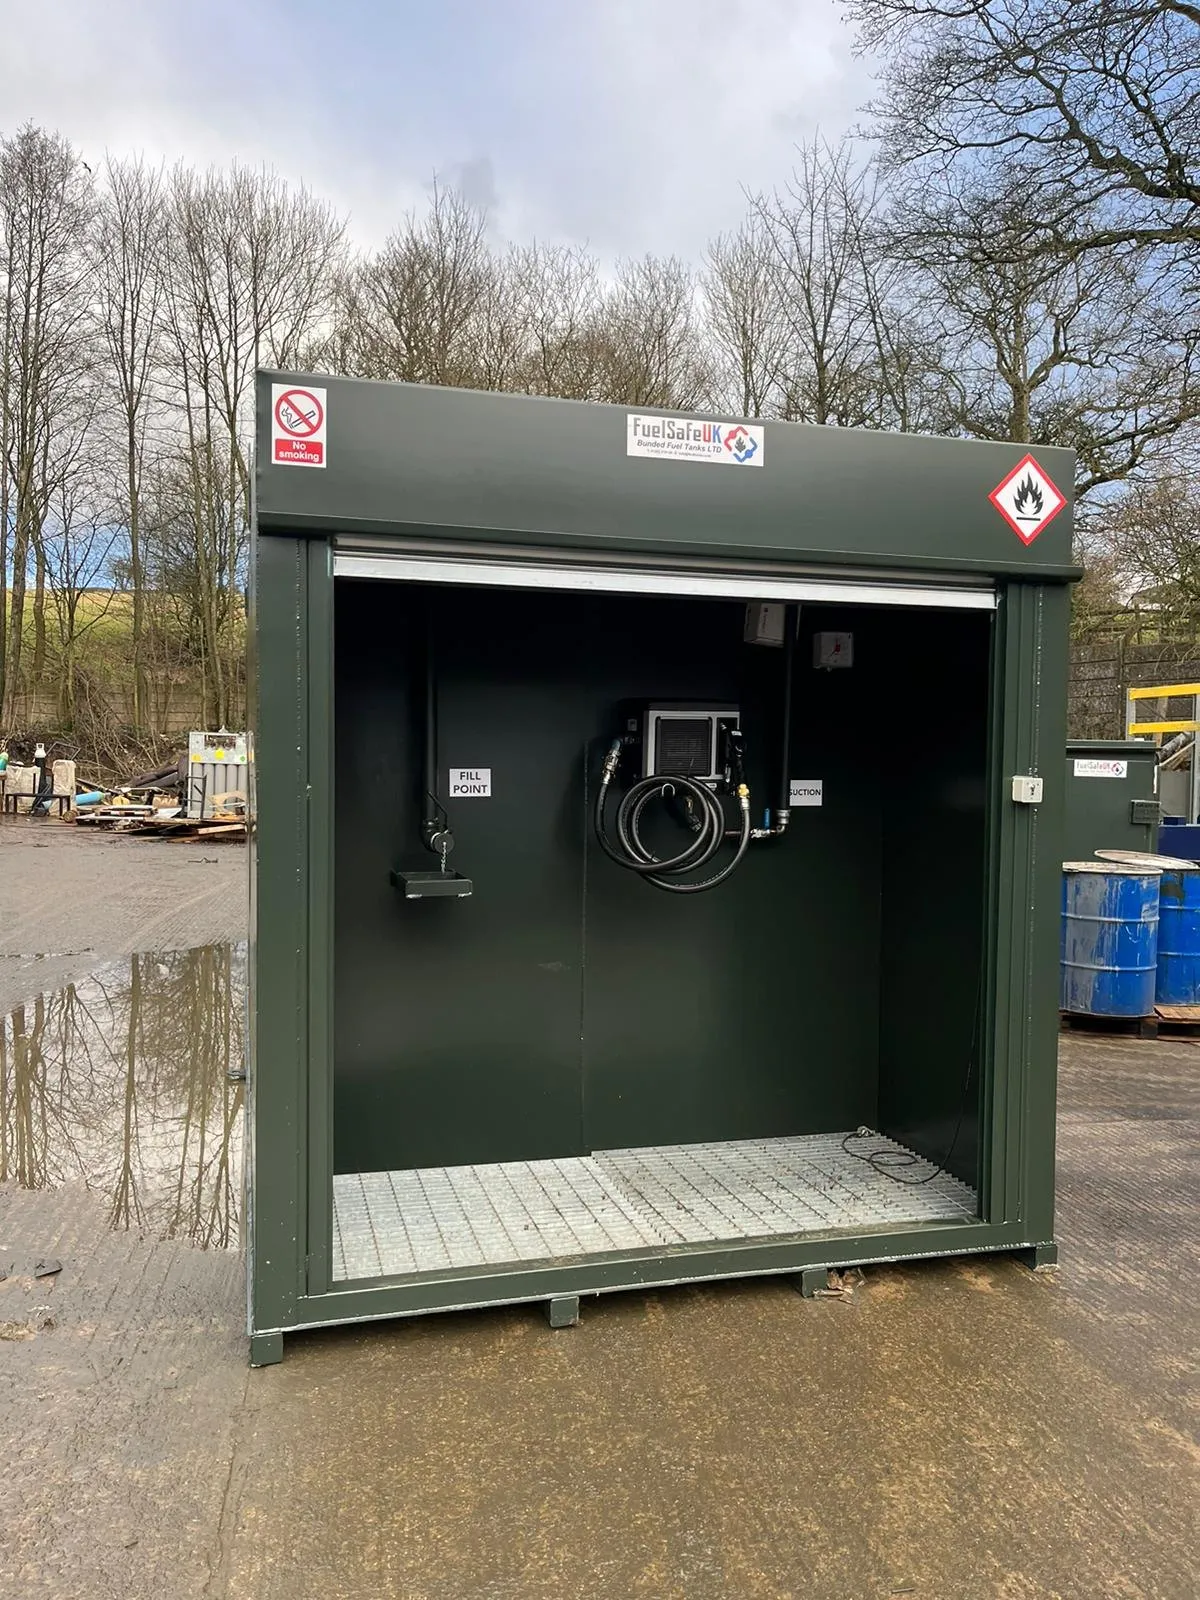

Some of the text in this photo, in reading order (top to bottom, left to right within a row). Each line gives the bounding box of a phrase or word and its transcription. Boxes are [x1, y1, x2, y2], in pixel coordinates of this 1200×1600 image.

[292, 441, 307, 450] No
[637, 439, 666, 449] Bunded
[666, 441, 683, 450] Fuel
[685, 444, 706, 453] Tanks
[707, 446, 722, 454] LTD
[278, 450, 320, 462] smoking
[459, 771, 481, 781] FILL
[453, 784, 488, 794] POINT
[789, 788, 821, 796] SUCTION
